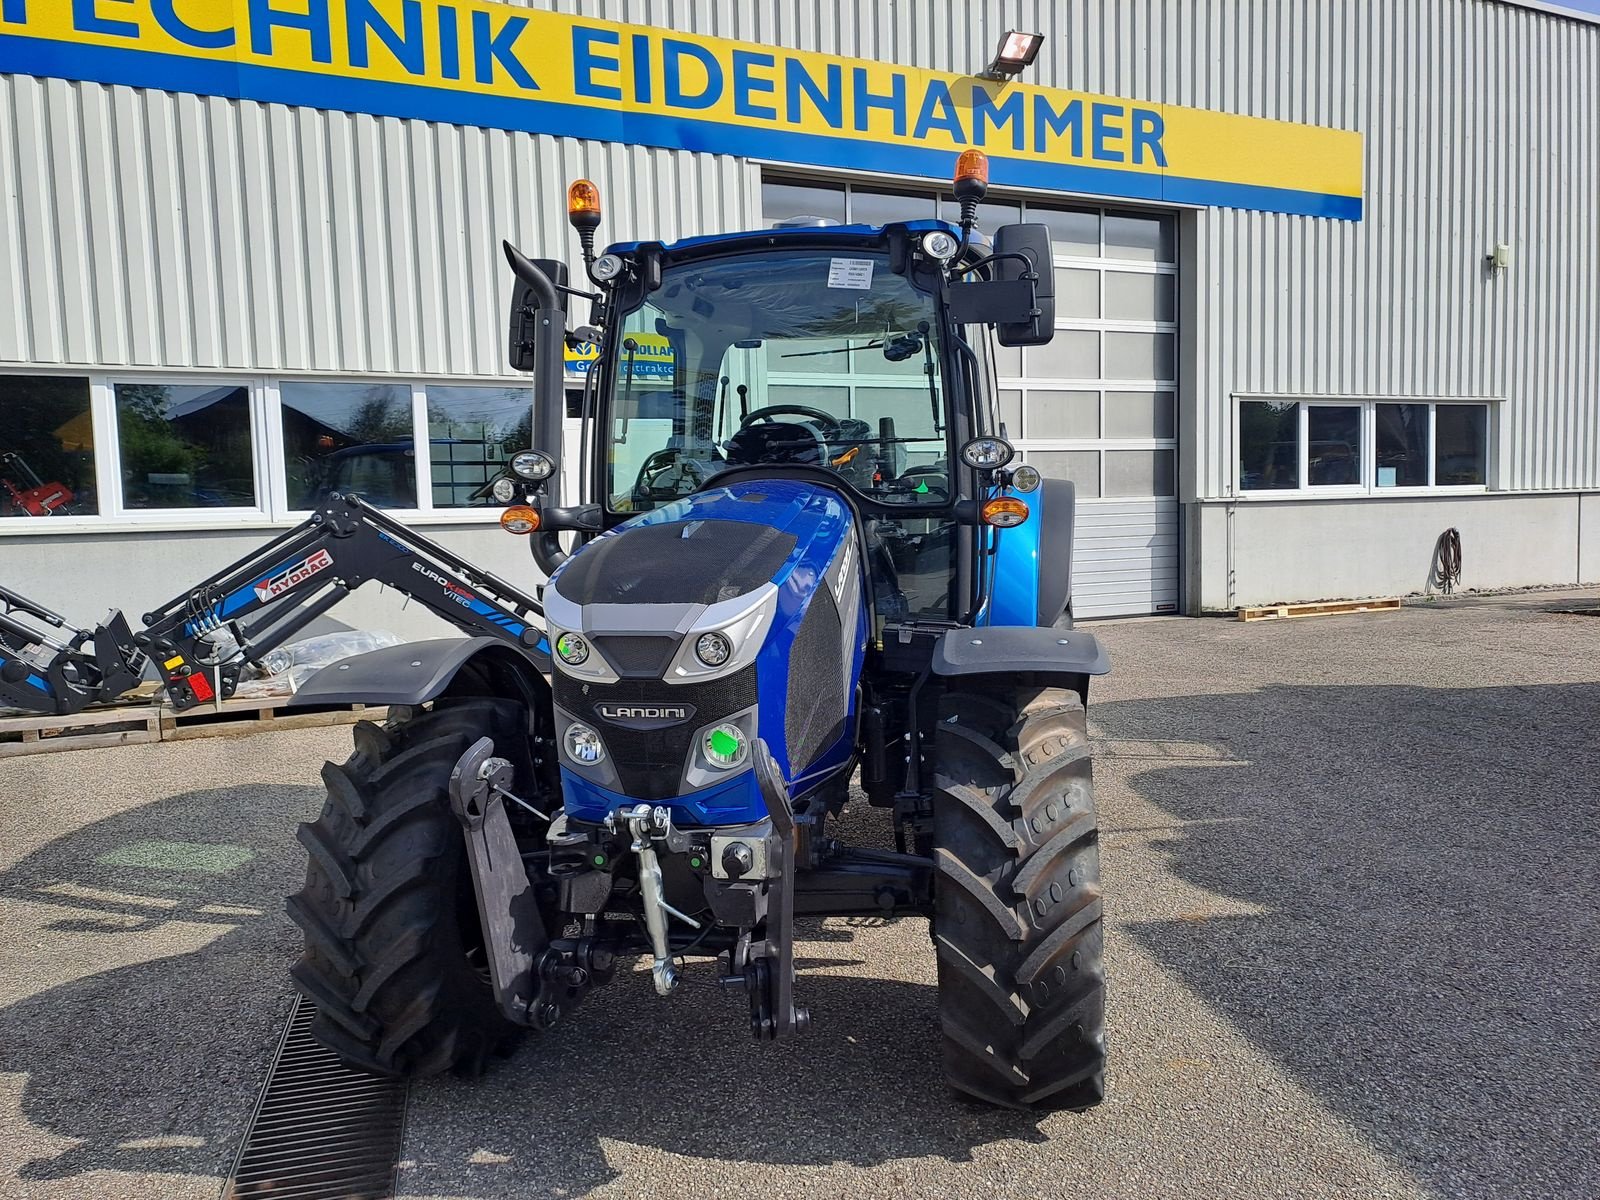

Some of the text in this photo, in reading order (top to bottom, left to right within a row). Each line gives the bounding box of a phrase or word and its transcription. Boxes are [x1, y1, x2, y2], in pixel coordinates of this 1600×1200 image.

[3, 0, 1169, 168] CHNIK EIDENHAMMER
[270, 558, 329, 595] HYDRAC
[443, 587, 471, 608] VITEC
[602, 707, 685, 718] LANDINI
